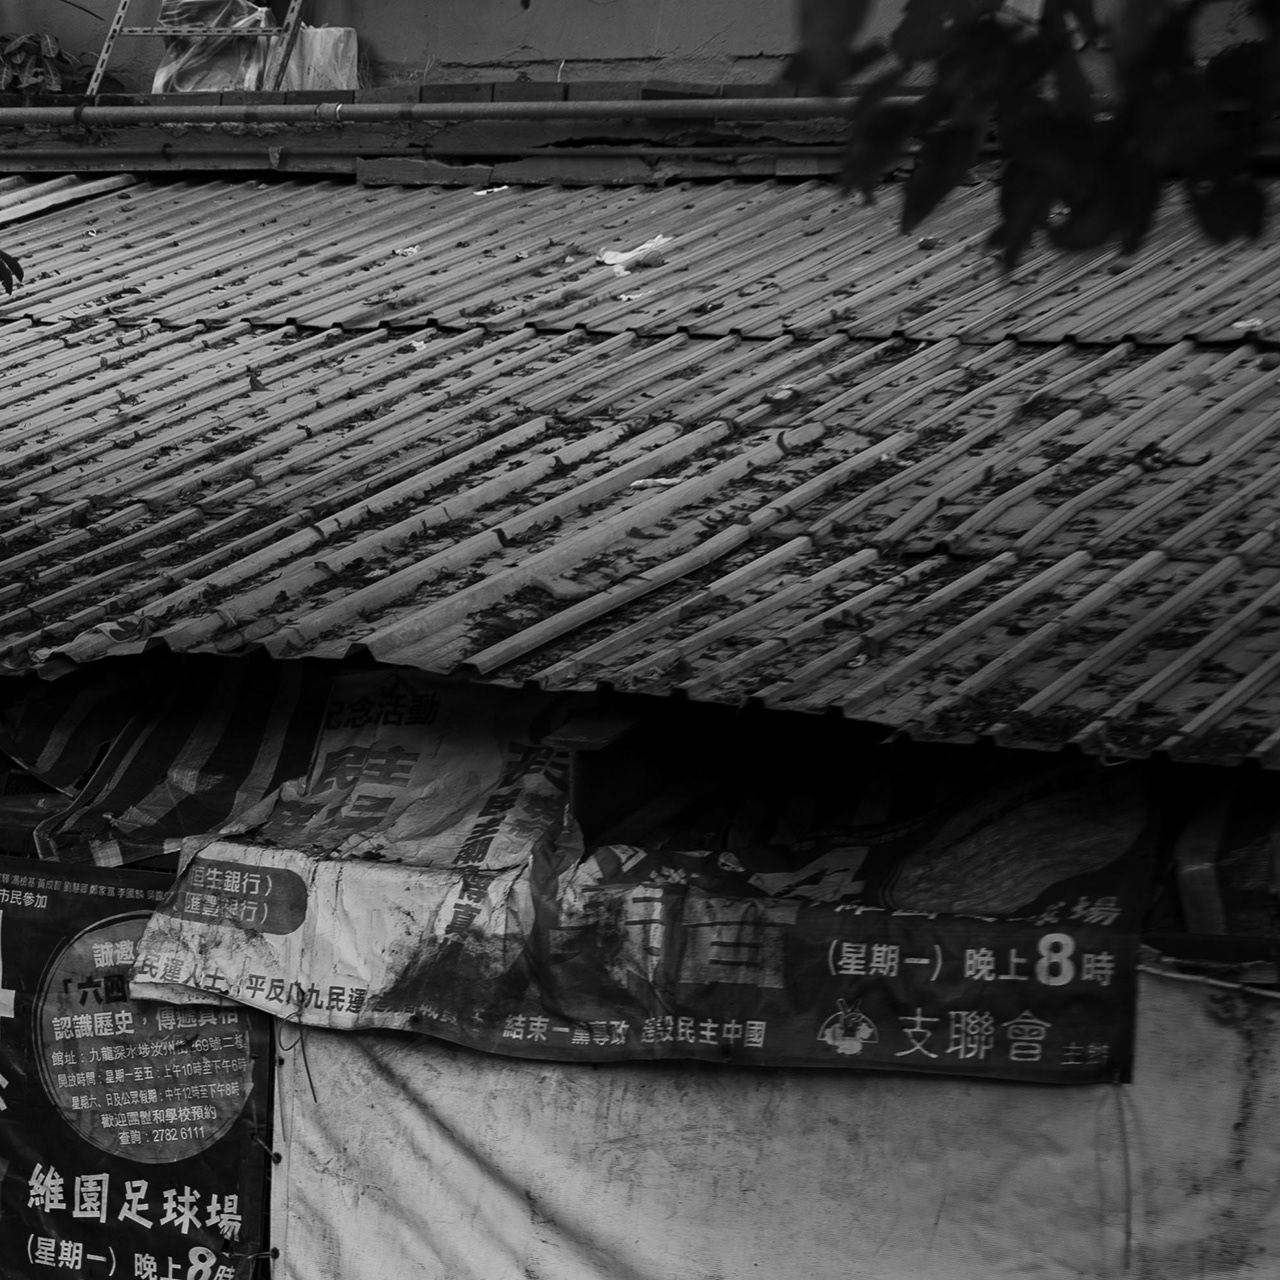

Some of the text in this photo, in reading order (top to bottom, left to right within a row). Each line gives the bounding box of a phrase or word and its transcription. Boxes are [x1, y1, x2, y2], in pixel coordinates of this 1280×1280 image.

[827, 932, 1117, 987] (星期一) 晚上8時
[894, 1007, 1053, 1063] 支聯會
[181, 1126, 205, 1141] 6111
[27, 1162, 243, 1242] 維園足球場
[27, 1233, 116, 1277] (星期一)
